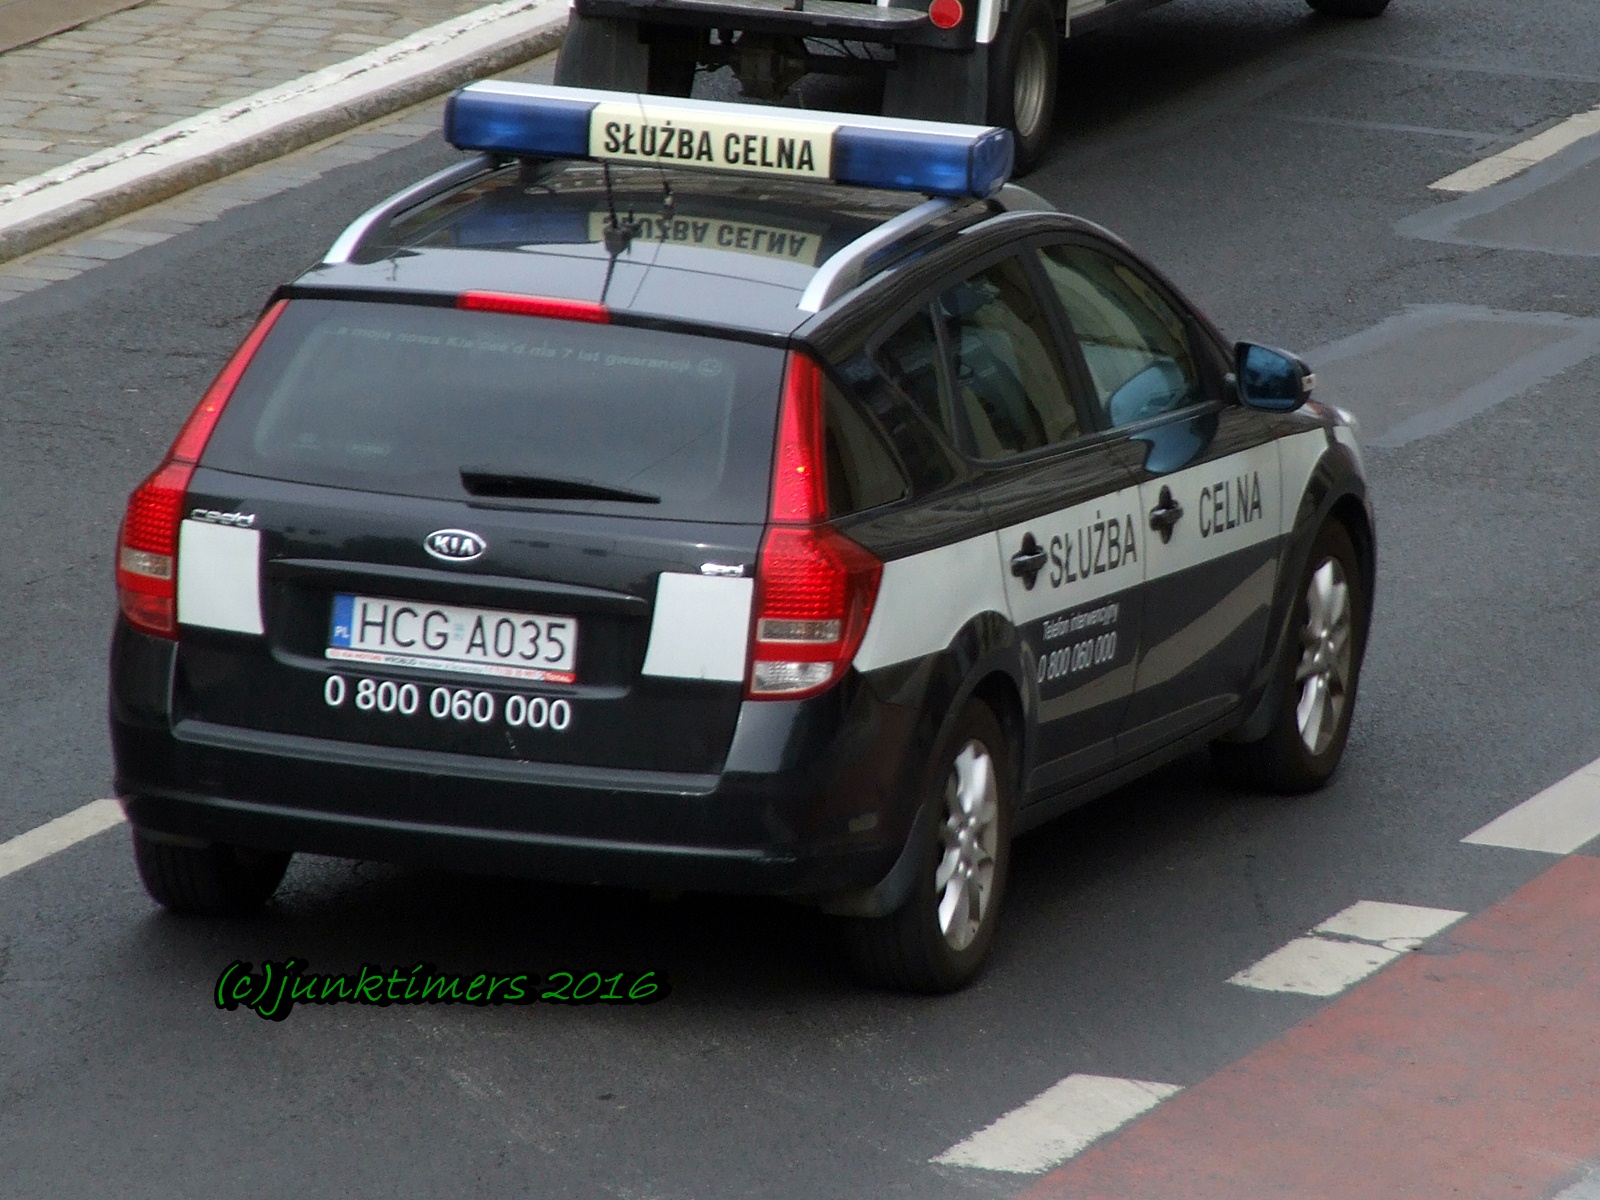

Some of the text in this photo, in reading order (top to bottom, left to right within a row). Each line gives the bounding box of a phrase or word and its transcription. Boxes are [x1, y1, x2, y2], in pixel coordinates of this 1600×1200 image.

[604, 120, 814, 171] SŁUŻBA CELNA
[562, 350, 573, 359] 7
[434, 535, 474, 555] KIA
[1050, 471, 1262, 588] SŁUŻBA CELNA
[334, 625, 350, 638] PL
[359, 602, 567, 663] HCG A035
[1037, 631, 1117, 683] 0 800 060 000
[324, 674, 571, 730] 0 800 060 000
